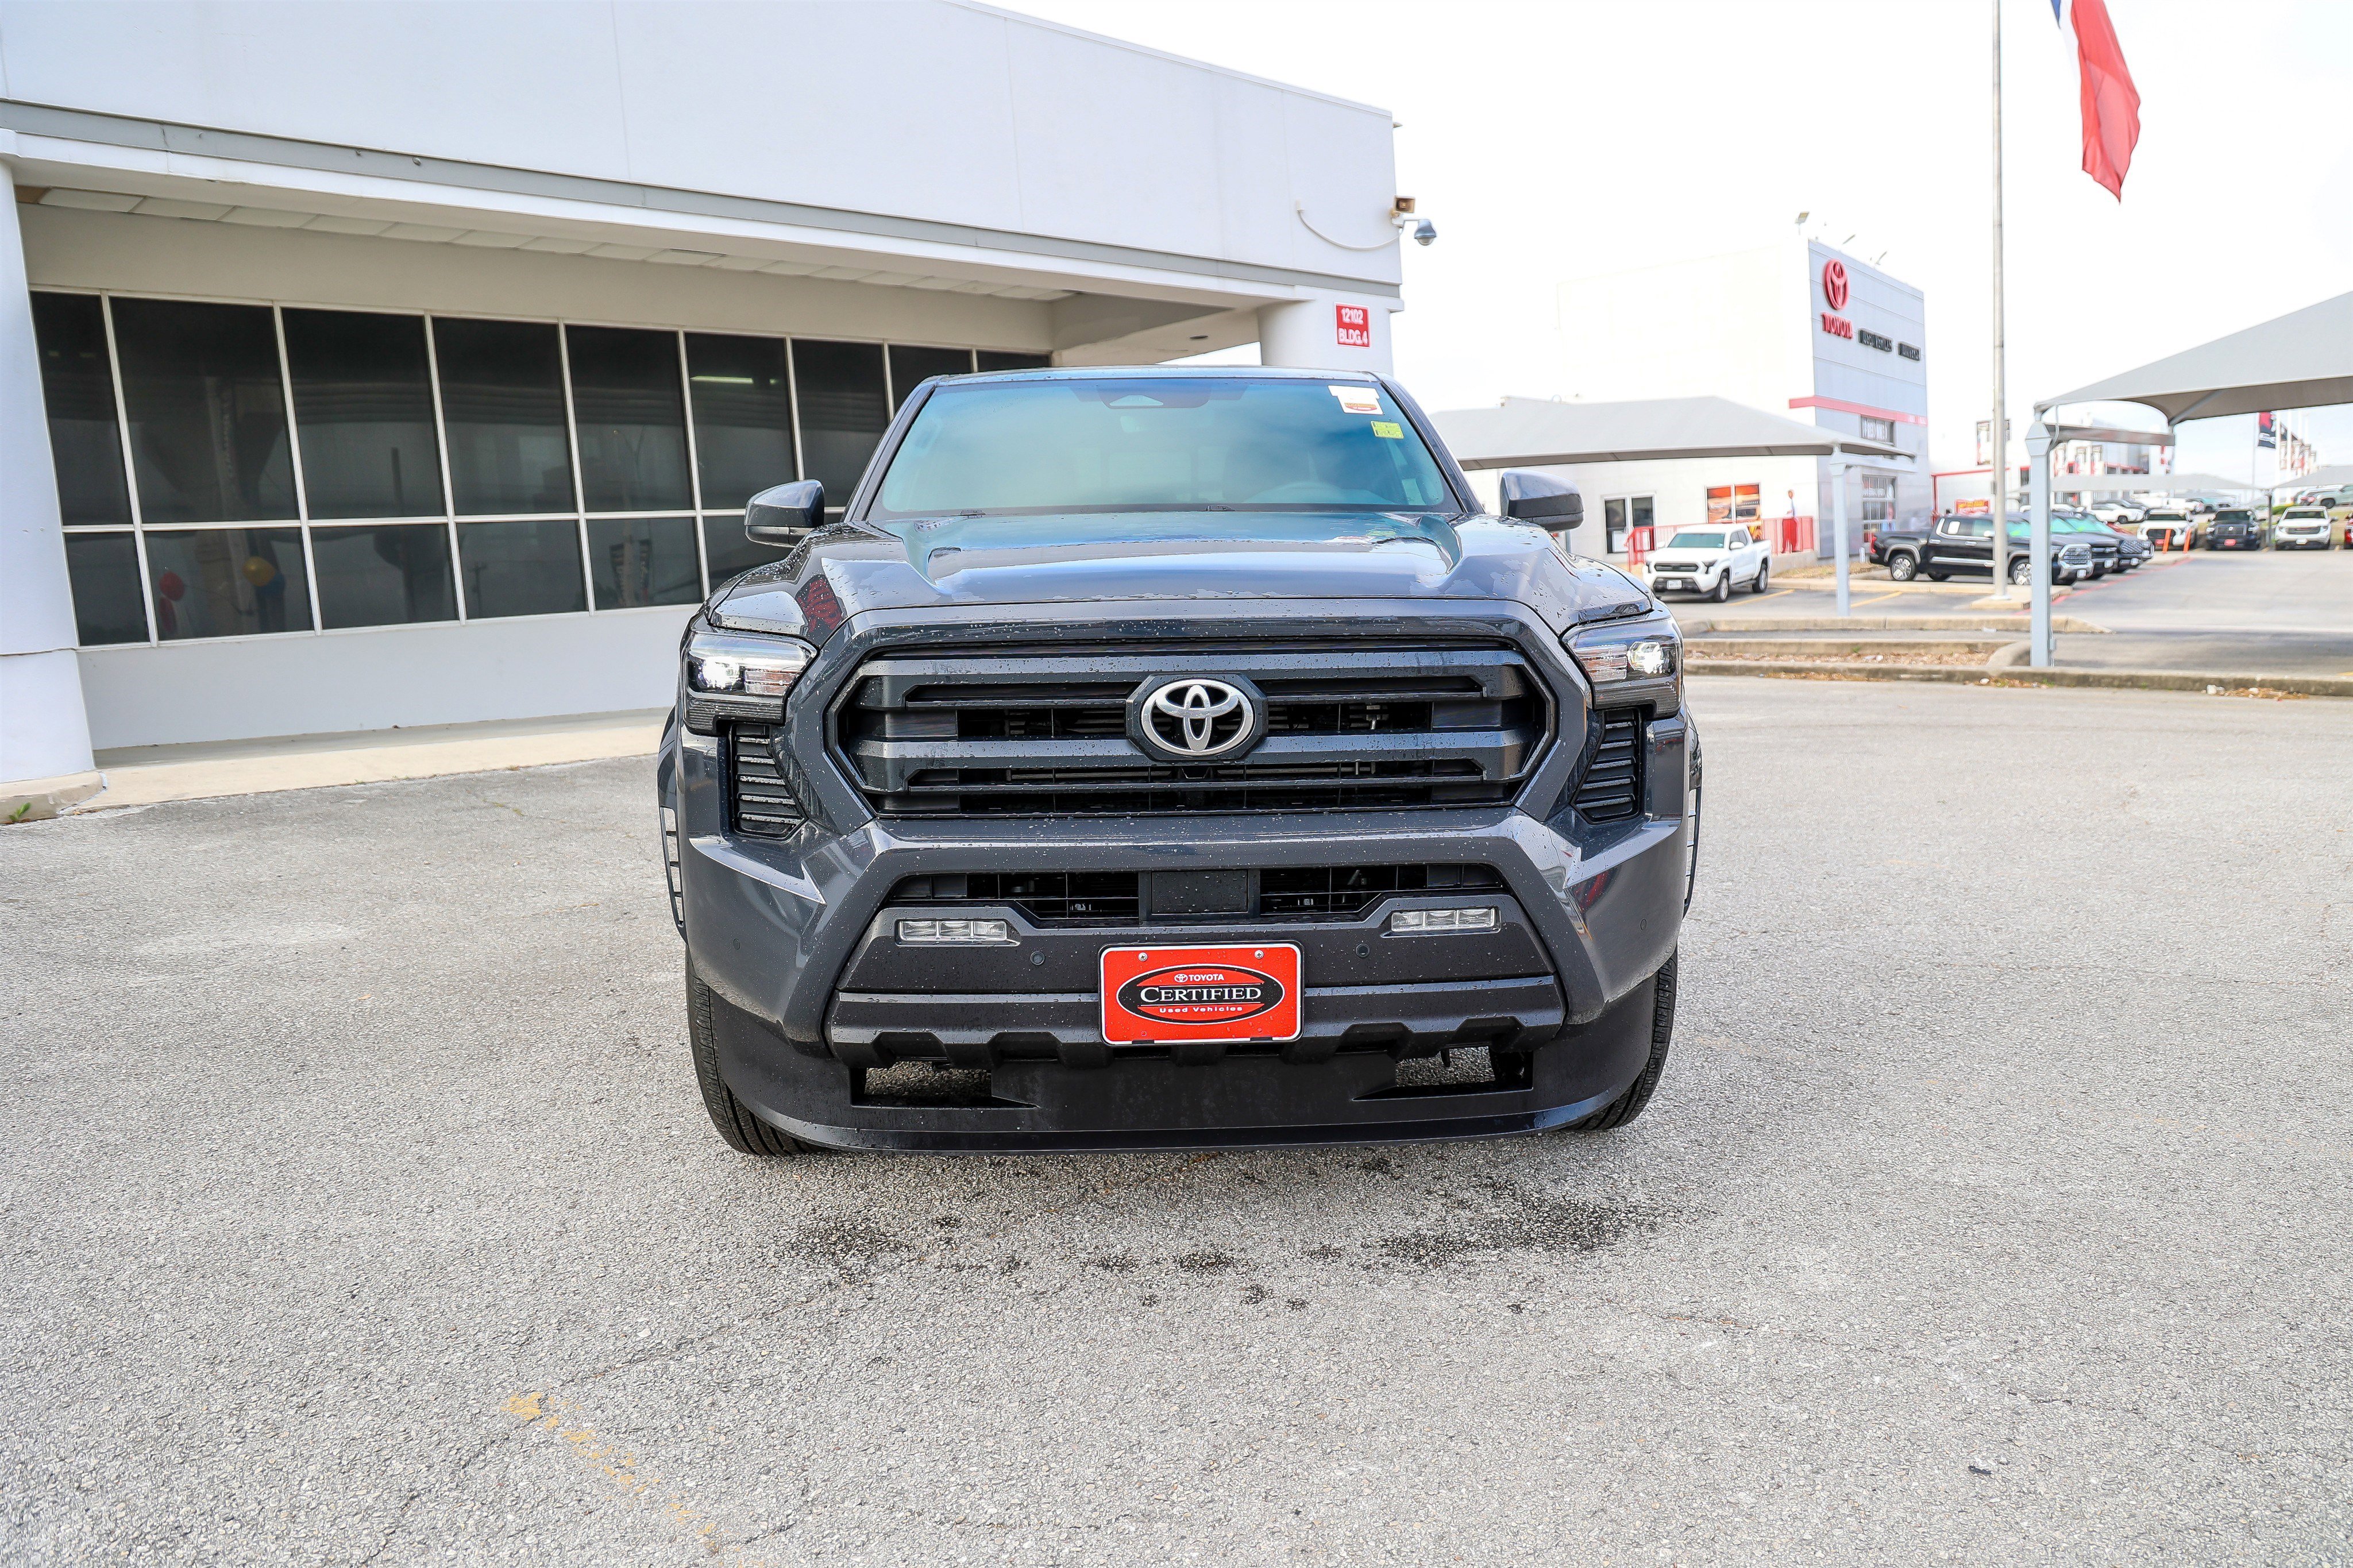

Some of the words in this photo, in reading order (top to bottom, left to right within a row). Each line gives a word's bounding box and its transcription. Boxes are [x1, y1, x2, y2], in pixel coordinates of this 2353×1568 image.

[1341, 307, 1364, 325] 12102
[1189, 974, 1224, 982] TOYOTA
[1140, 987, 1262, 1003] CERTIFIED
